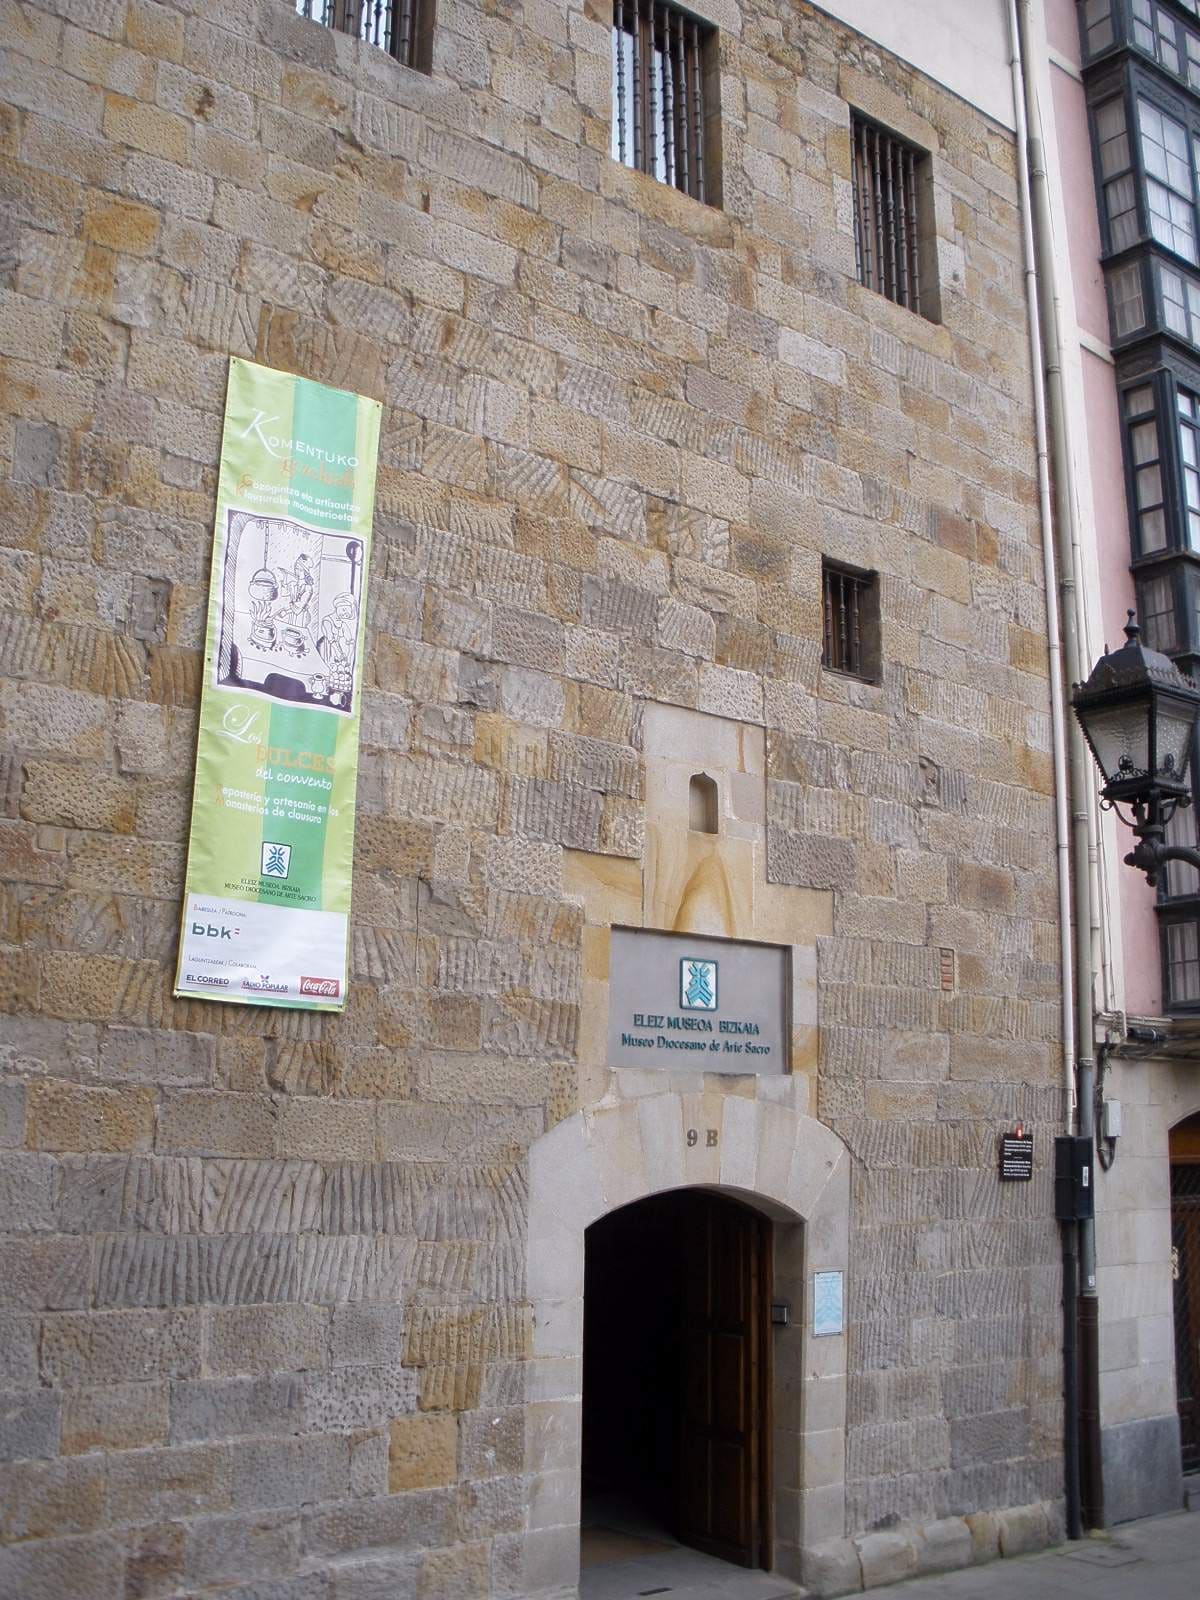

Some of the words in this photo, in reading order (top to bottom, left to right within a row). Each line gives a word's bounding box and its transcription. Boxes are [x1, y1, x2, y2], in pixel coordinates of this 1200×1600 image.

[255, 745, 337, 772] DULCES
[255, 768, 274, 781] del
[277, 771, 333, 791] convento
[272, 806, 286, 818] de
[287, 808, 322, 824] clausura
[317, 804, 327, 814] en
[328, 805, 340, 817] los
[224, 882, 244, 891] MUSEO
[245, 886, 276, 898] DIOCESANO
[192, 922, 232, 940] bbk
[186, 974, 197, 983] EL
[198, 976, 230, 986] CORREO
[262, 981, 289, 990] POPULAR
[633, 1013, 664, 1029] ELEIZ
[667, 1016, 713, 1032] MUSEOA
[719, 1020, 760, 1035] BIZKAIA
[621, 1033, 655, 1048] Museo
[657, 1036, 707, 1052] Diocesano
[709, 1039, 721, 1052] de
[722, 1039, 743, 1054] Arte
[745, 1042, 771, 1056] Sacro
[687, 1129, 698, 1147] 9
[706, 1129, 718, 1147] B
